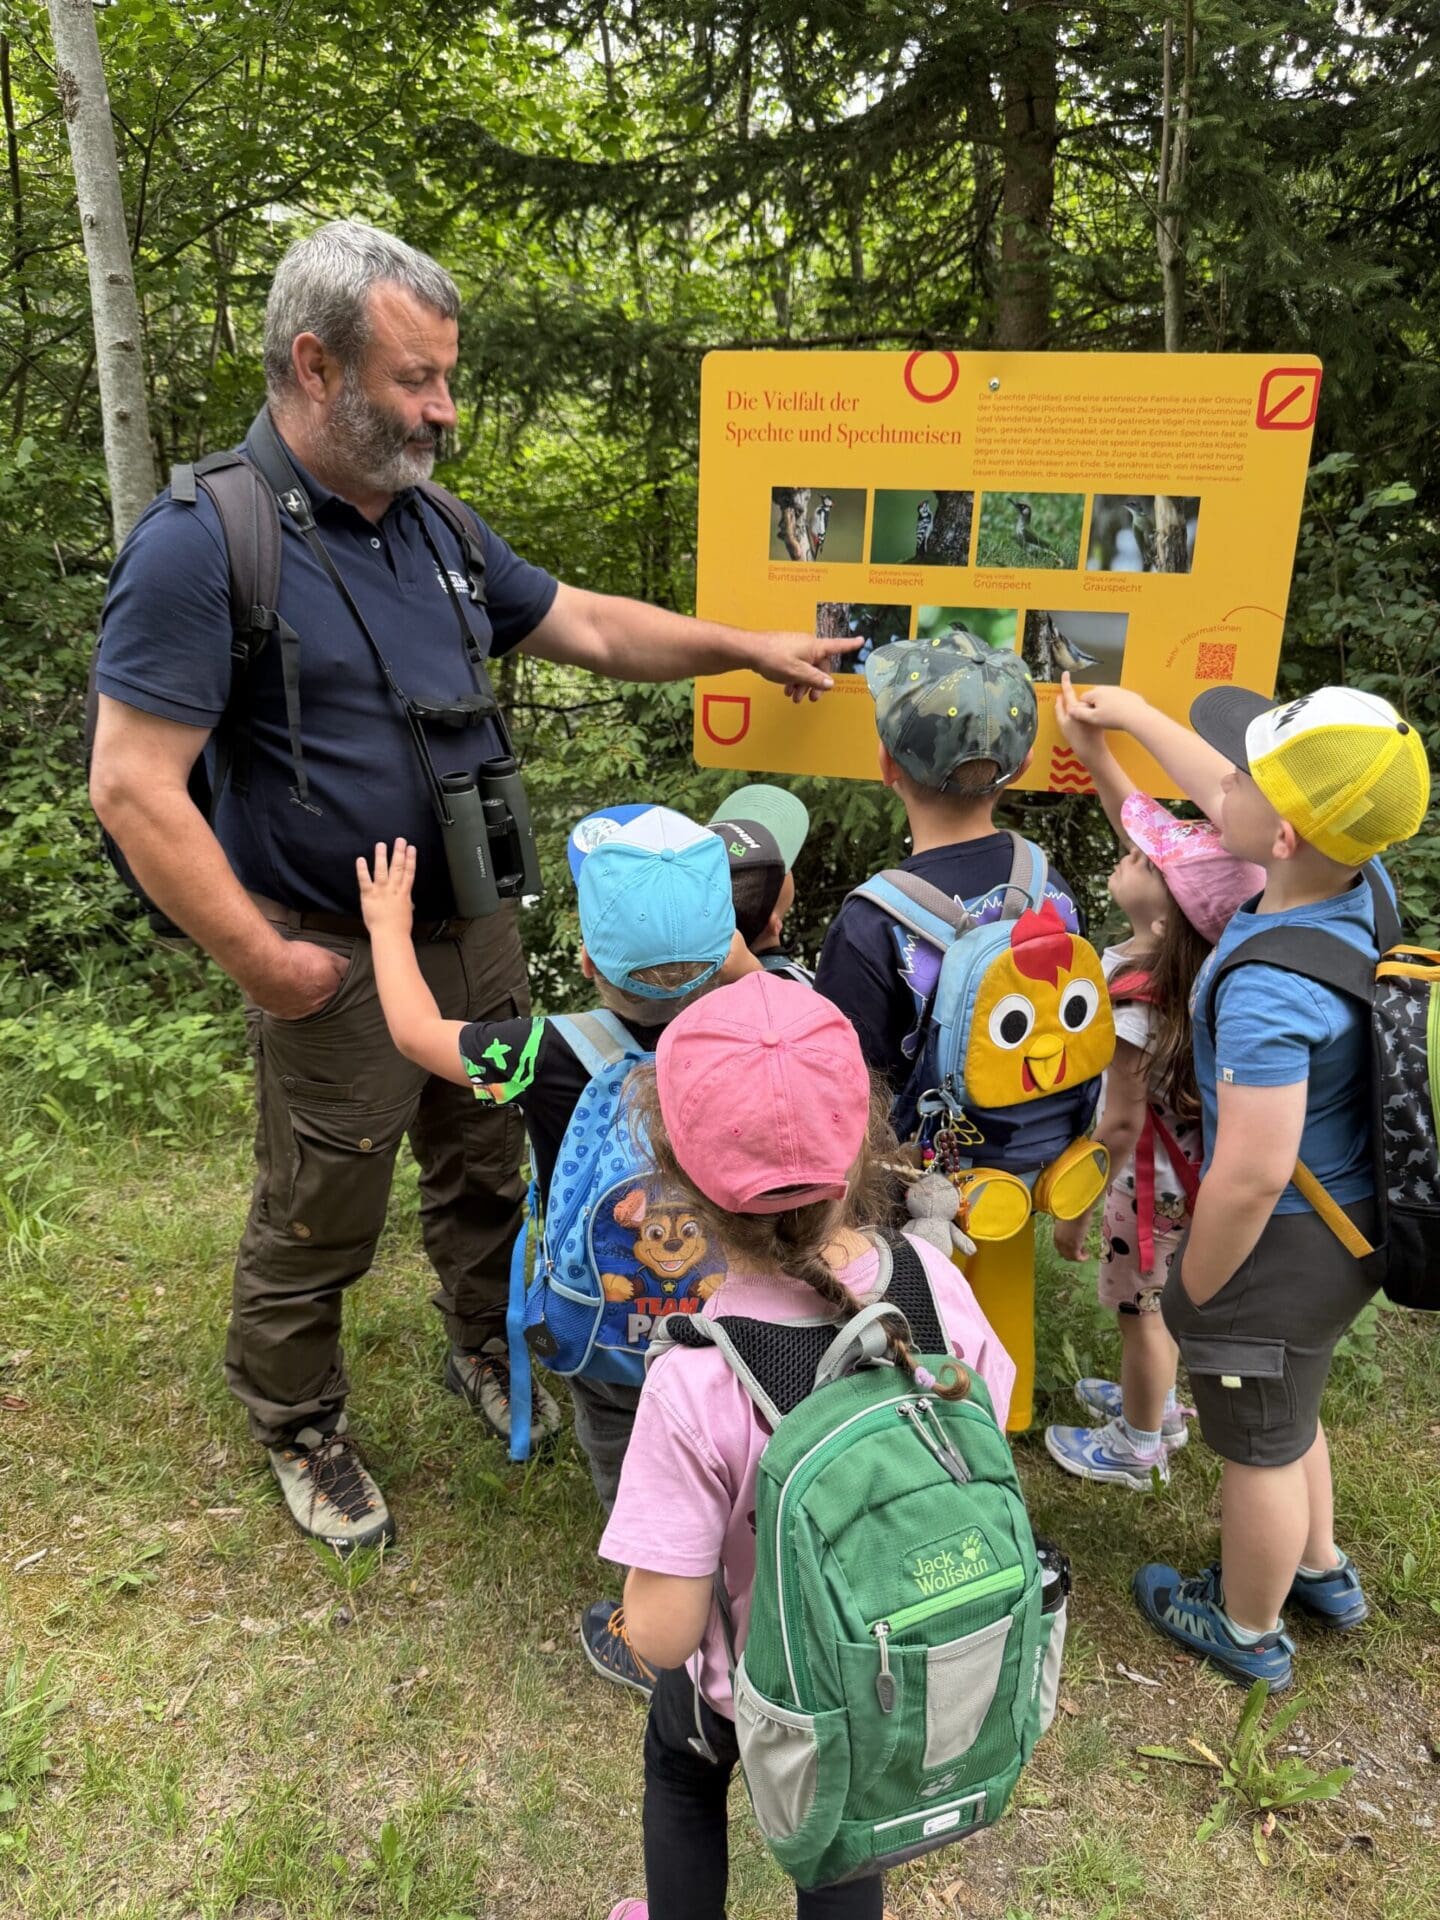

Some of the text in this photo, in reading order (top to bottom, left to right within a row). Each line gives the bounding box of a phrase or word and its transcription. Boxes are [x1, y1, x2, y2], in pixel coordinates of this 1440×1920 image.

[727, 390, 860, 412] Die Vielfalt der
[726, 421, 962, 449] Spechte und Spechtmeisen
[768, 572, 820, 584] Buntspecht
[869, 576, 924, 586] Kleinspecht
[974, 578, 1032, 590] Grünspecht
[1083, 583, 1142, 593] Grauspecht
[634, 1297, 699, 1316] TEAM
[912, 1550, 954, 1577] Jack
[914, 1558, 988, 1596] Wolfskin
